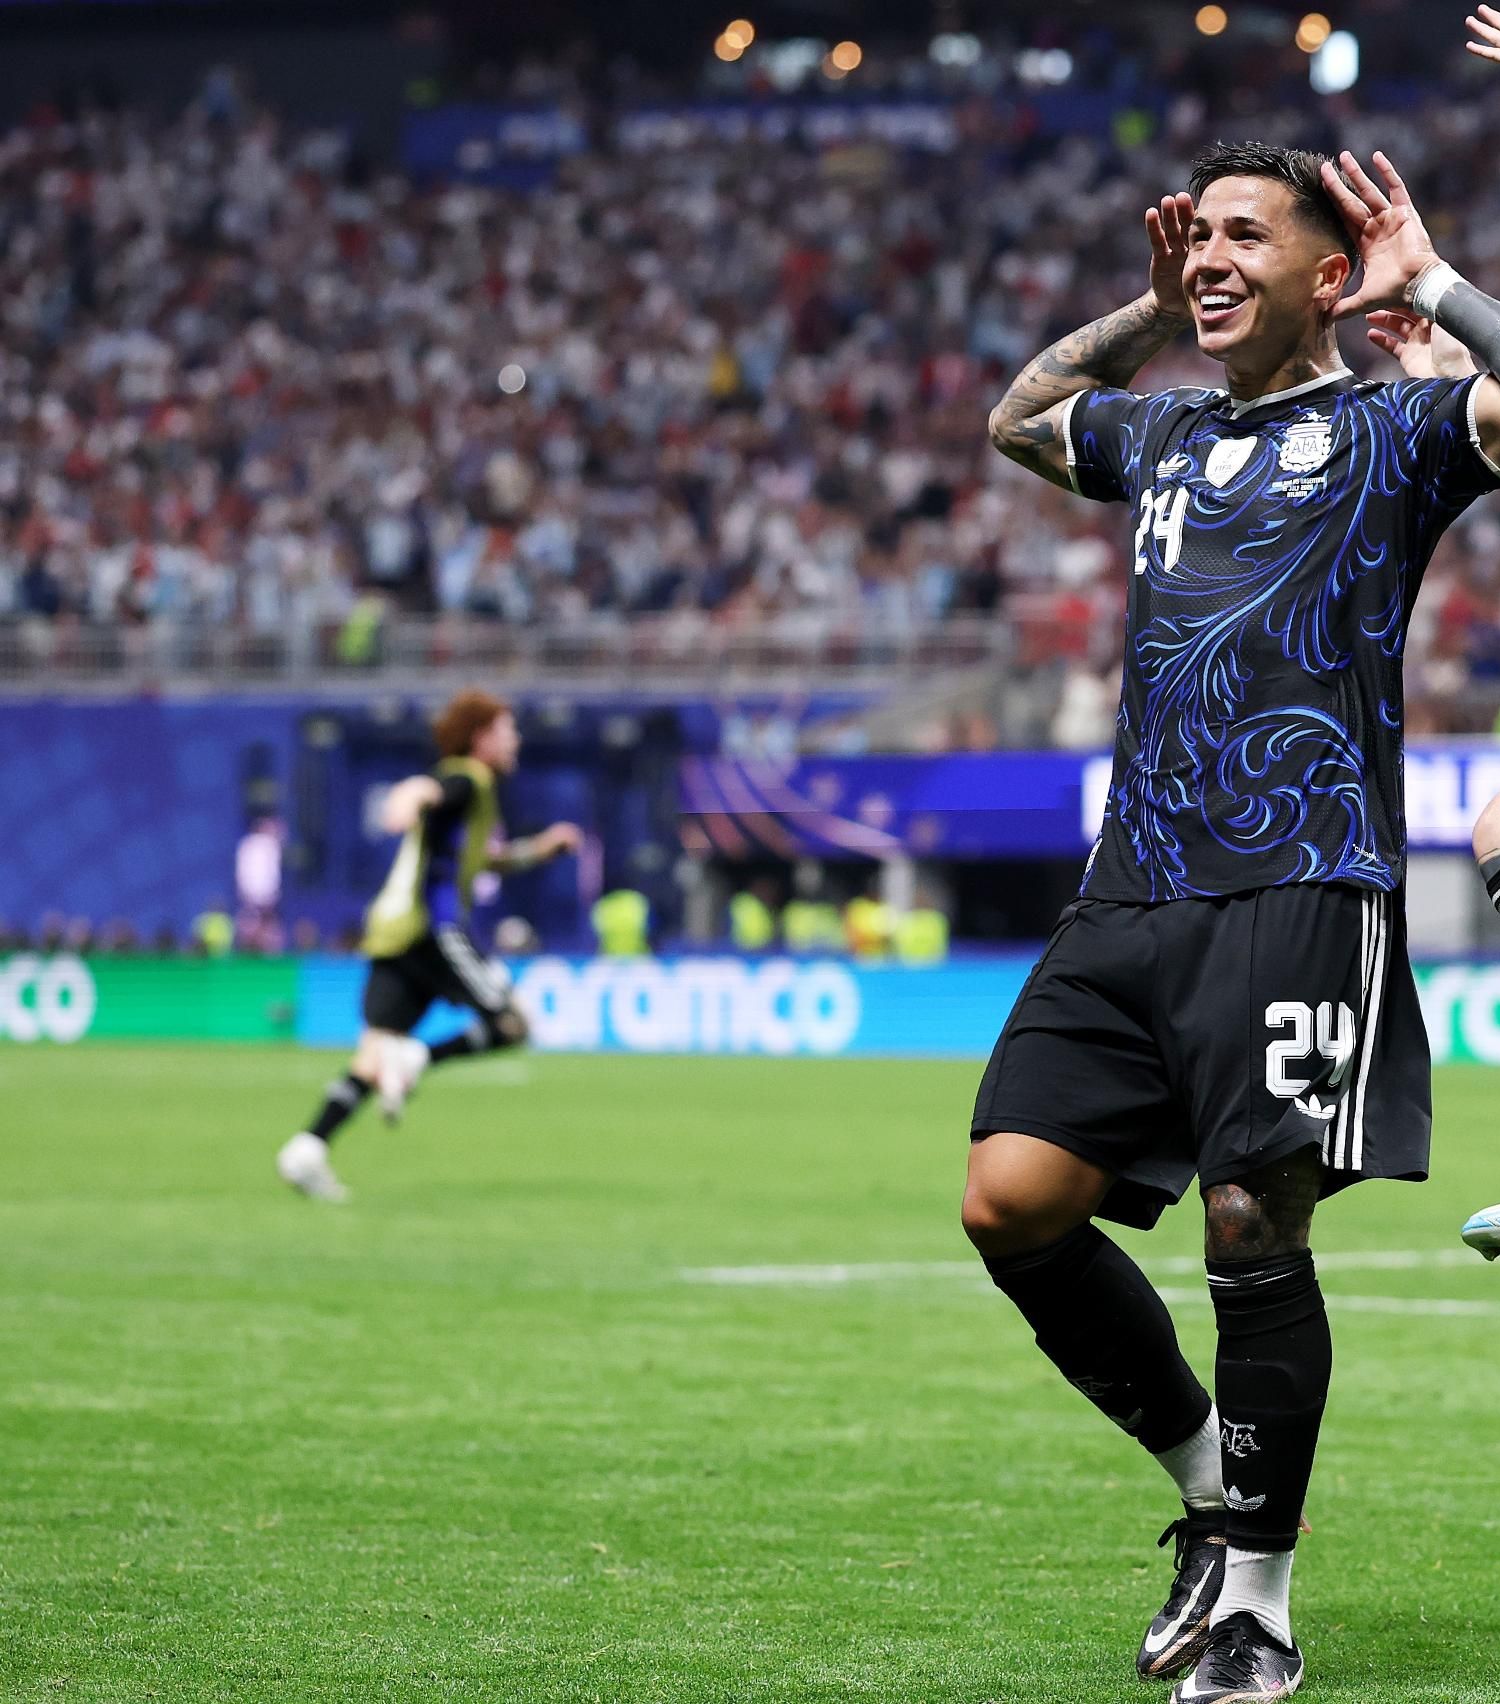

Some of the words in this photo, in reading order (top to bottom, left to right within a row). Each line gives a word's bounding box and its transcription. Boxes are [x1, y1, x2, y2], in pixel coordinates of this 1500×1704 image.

[1134, 487, 1190, 575] 24
[514, 955, 861, 1054] aramco
[1265, 1001, 1357, 1098] 24
